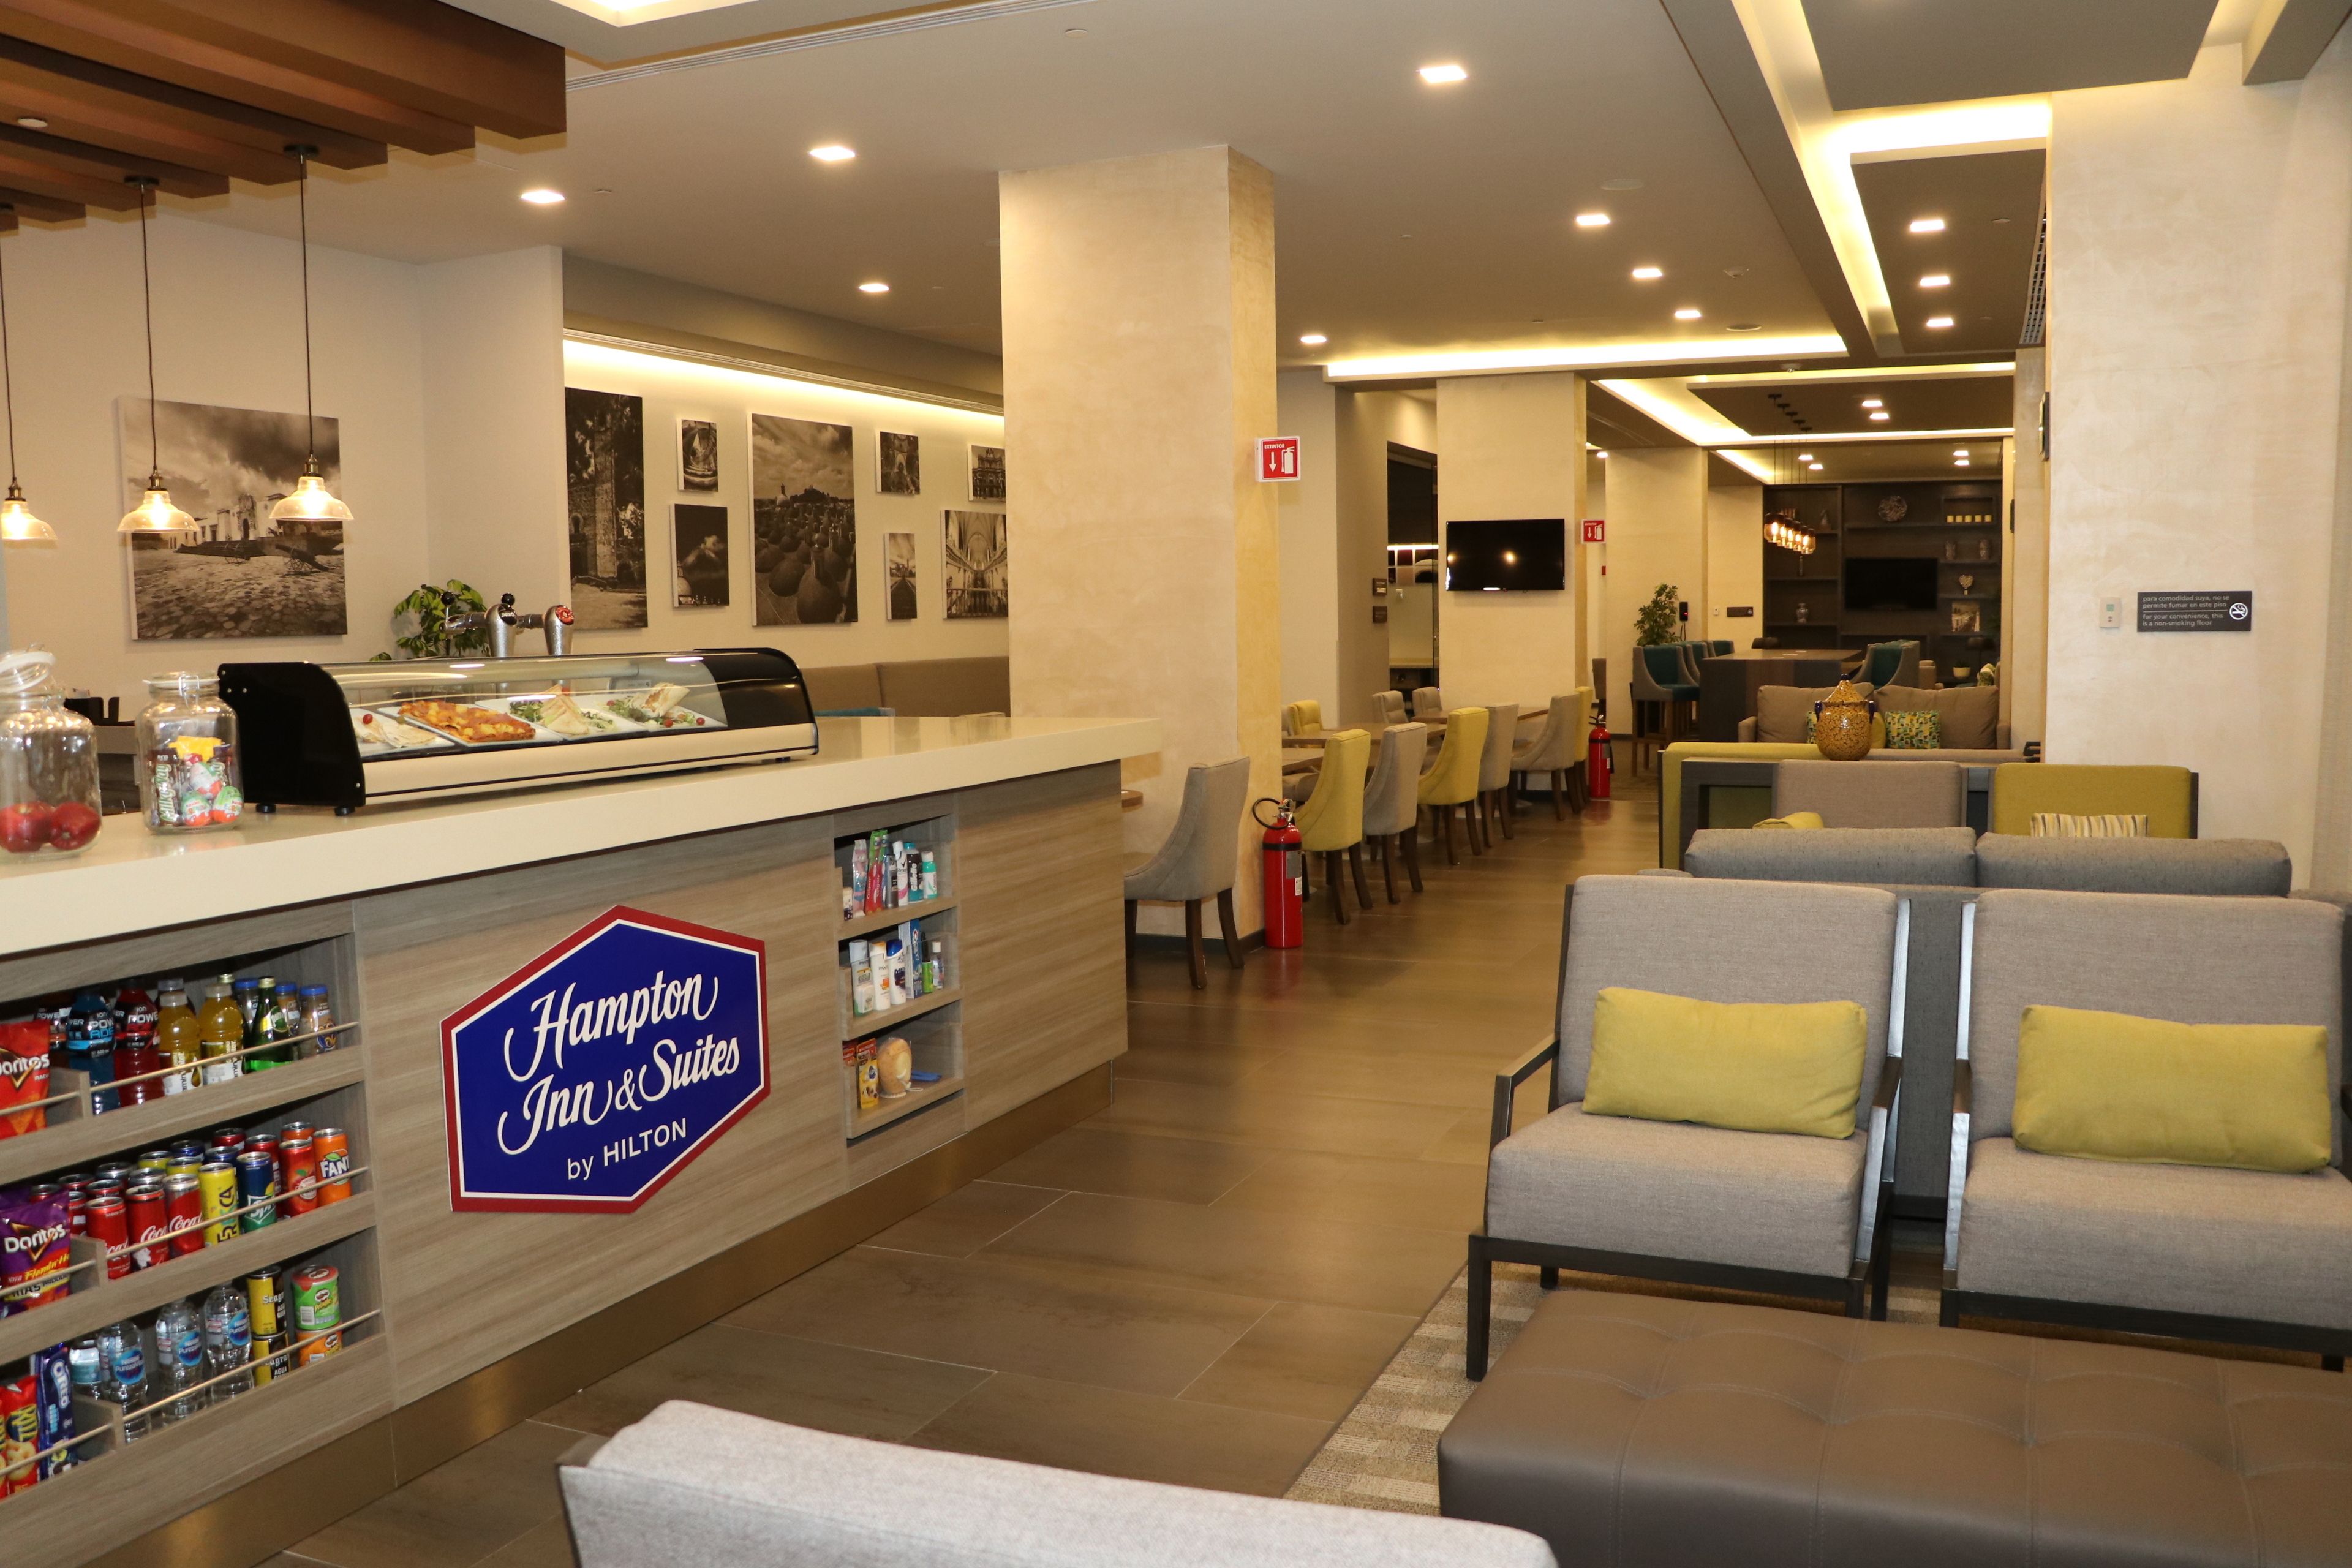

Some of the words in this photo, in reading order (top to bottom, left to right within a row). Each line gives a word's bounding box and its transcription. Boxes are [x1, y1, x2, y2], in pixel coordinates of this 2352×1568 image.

[503, 970, 718, 1082] Hampton
[497, 1074, 613, 1155] Inn
[614, 1069, 643, 1112] &
[639, 1034, 741, 1102] Suites
[320, 1155, 349, 1179] FANT
[567, 1155, 594, 1180] by
[603, 1117, 687, 1167] HILTON
[4, 1224, 66, 1253] Doritos
[51, 1359, 69, 1409] OREO
